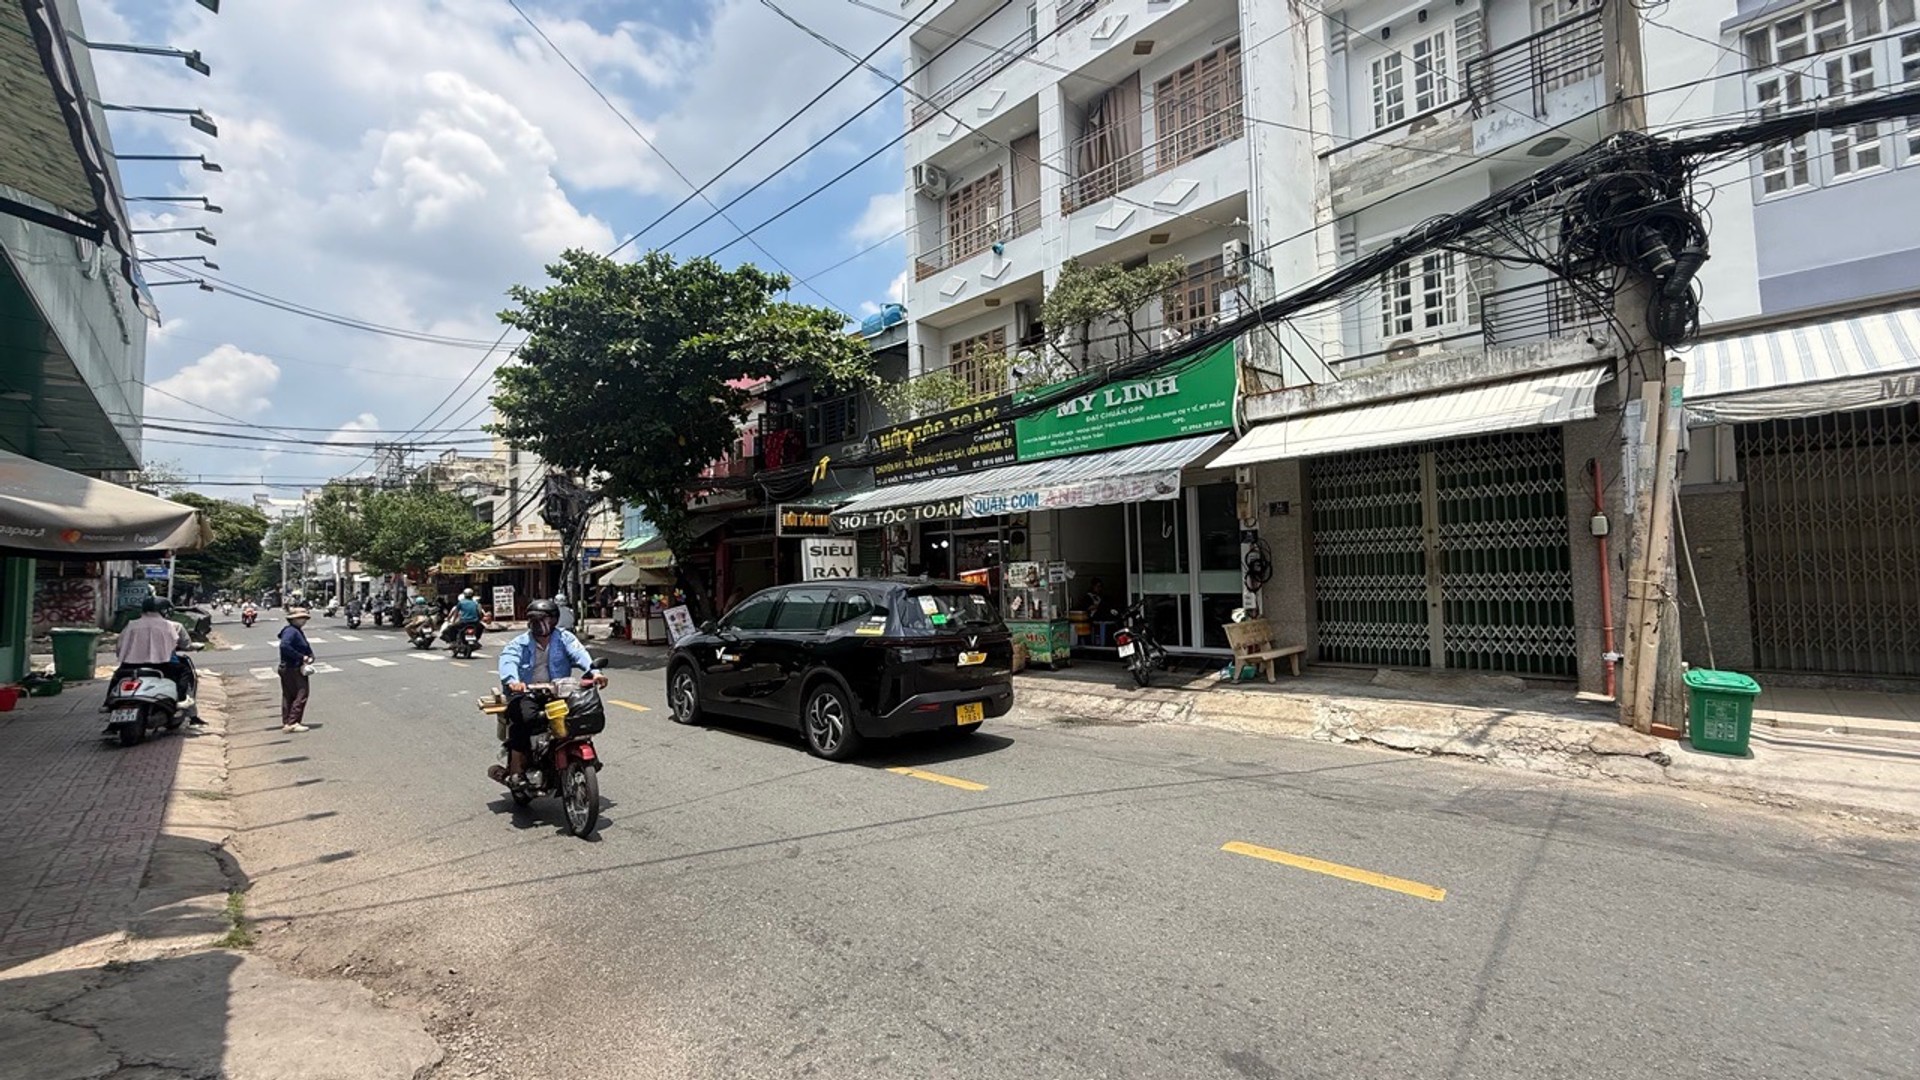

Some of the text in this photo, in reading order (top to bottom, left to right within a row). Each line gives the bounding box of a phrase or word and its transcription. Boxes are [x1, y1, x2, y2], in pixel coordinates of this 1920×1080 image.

[1104, 375, 1179, 407] LINH
[810, 542, 853, 557] SIÊU
[813, 563, 853, 578] RÁY
